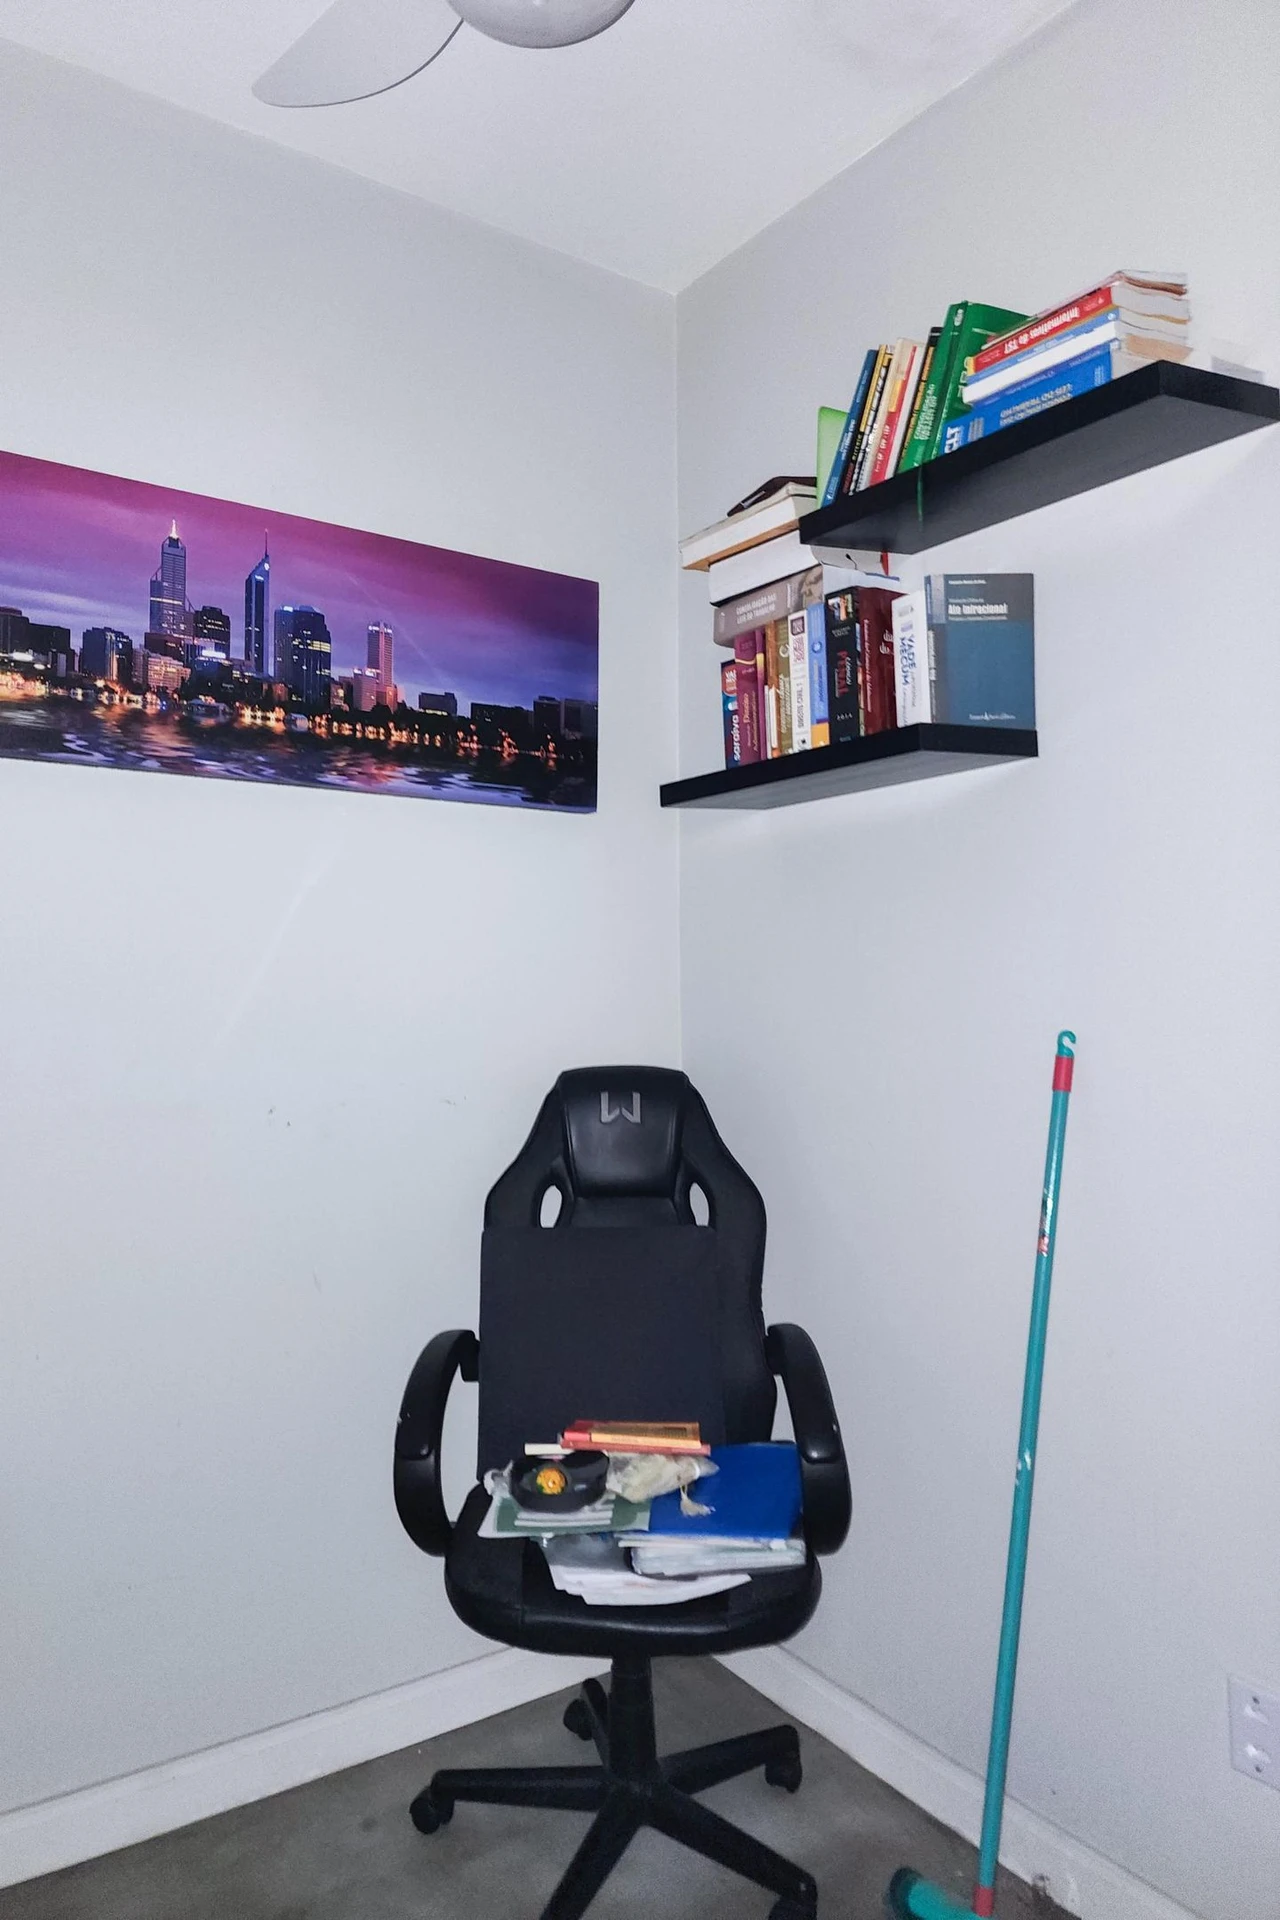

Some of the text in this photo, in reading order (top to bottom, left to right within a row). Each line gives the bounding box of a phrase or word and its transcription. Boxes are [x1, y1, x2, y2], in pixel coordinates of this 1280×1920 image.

[1018, 330, 1029, 345] do
[1030, 306, 1080, 339] Informativos
[1004, 338, 1019, 354] TST
[944, 426, 960, 452] CLT
[899, 636, 909, 685] MECUM
[906, 634, 916, 668] VADE
[836, 650, 849, 696] PENAL
[732, 714, 741, 760] saraiva
